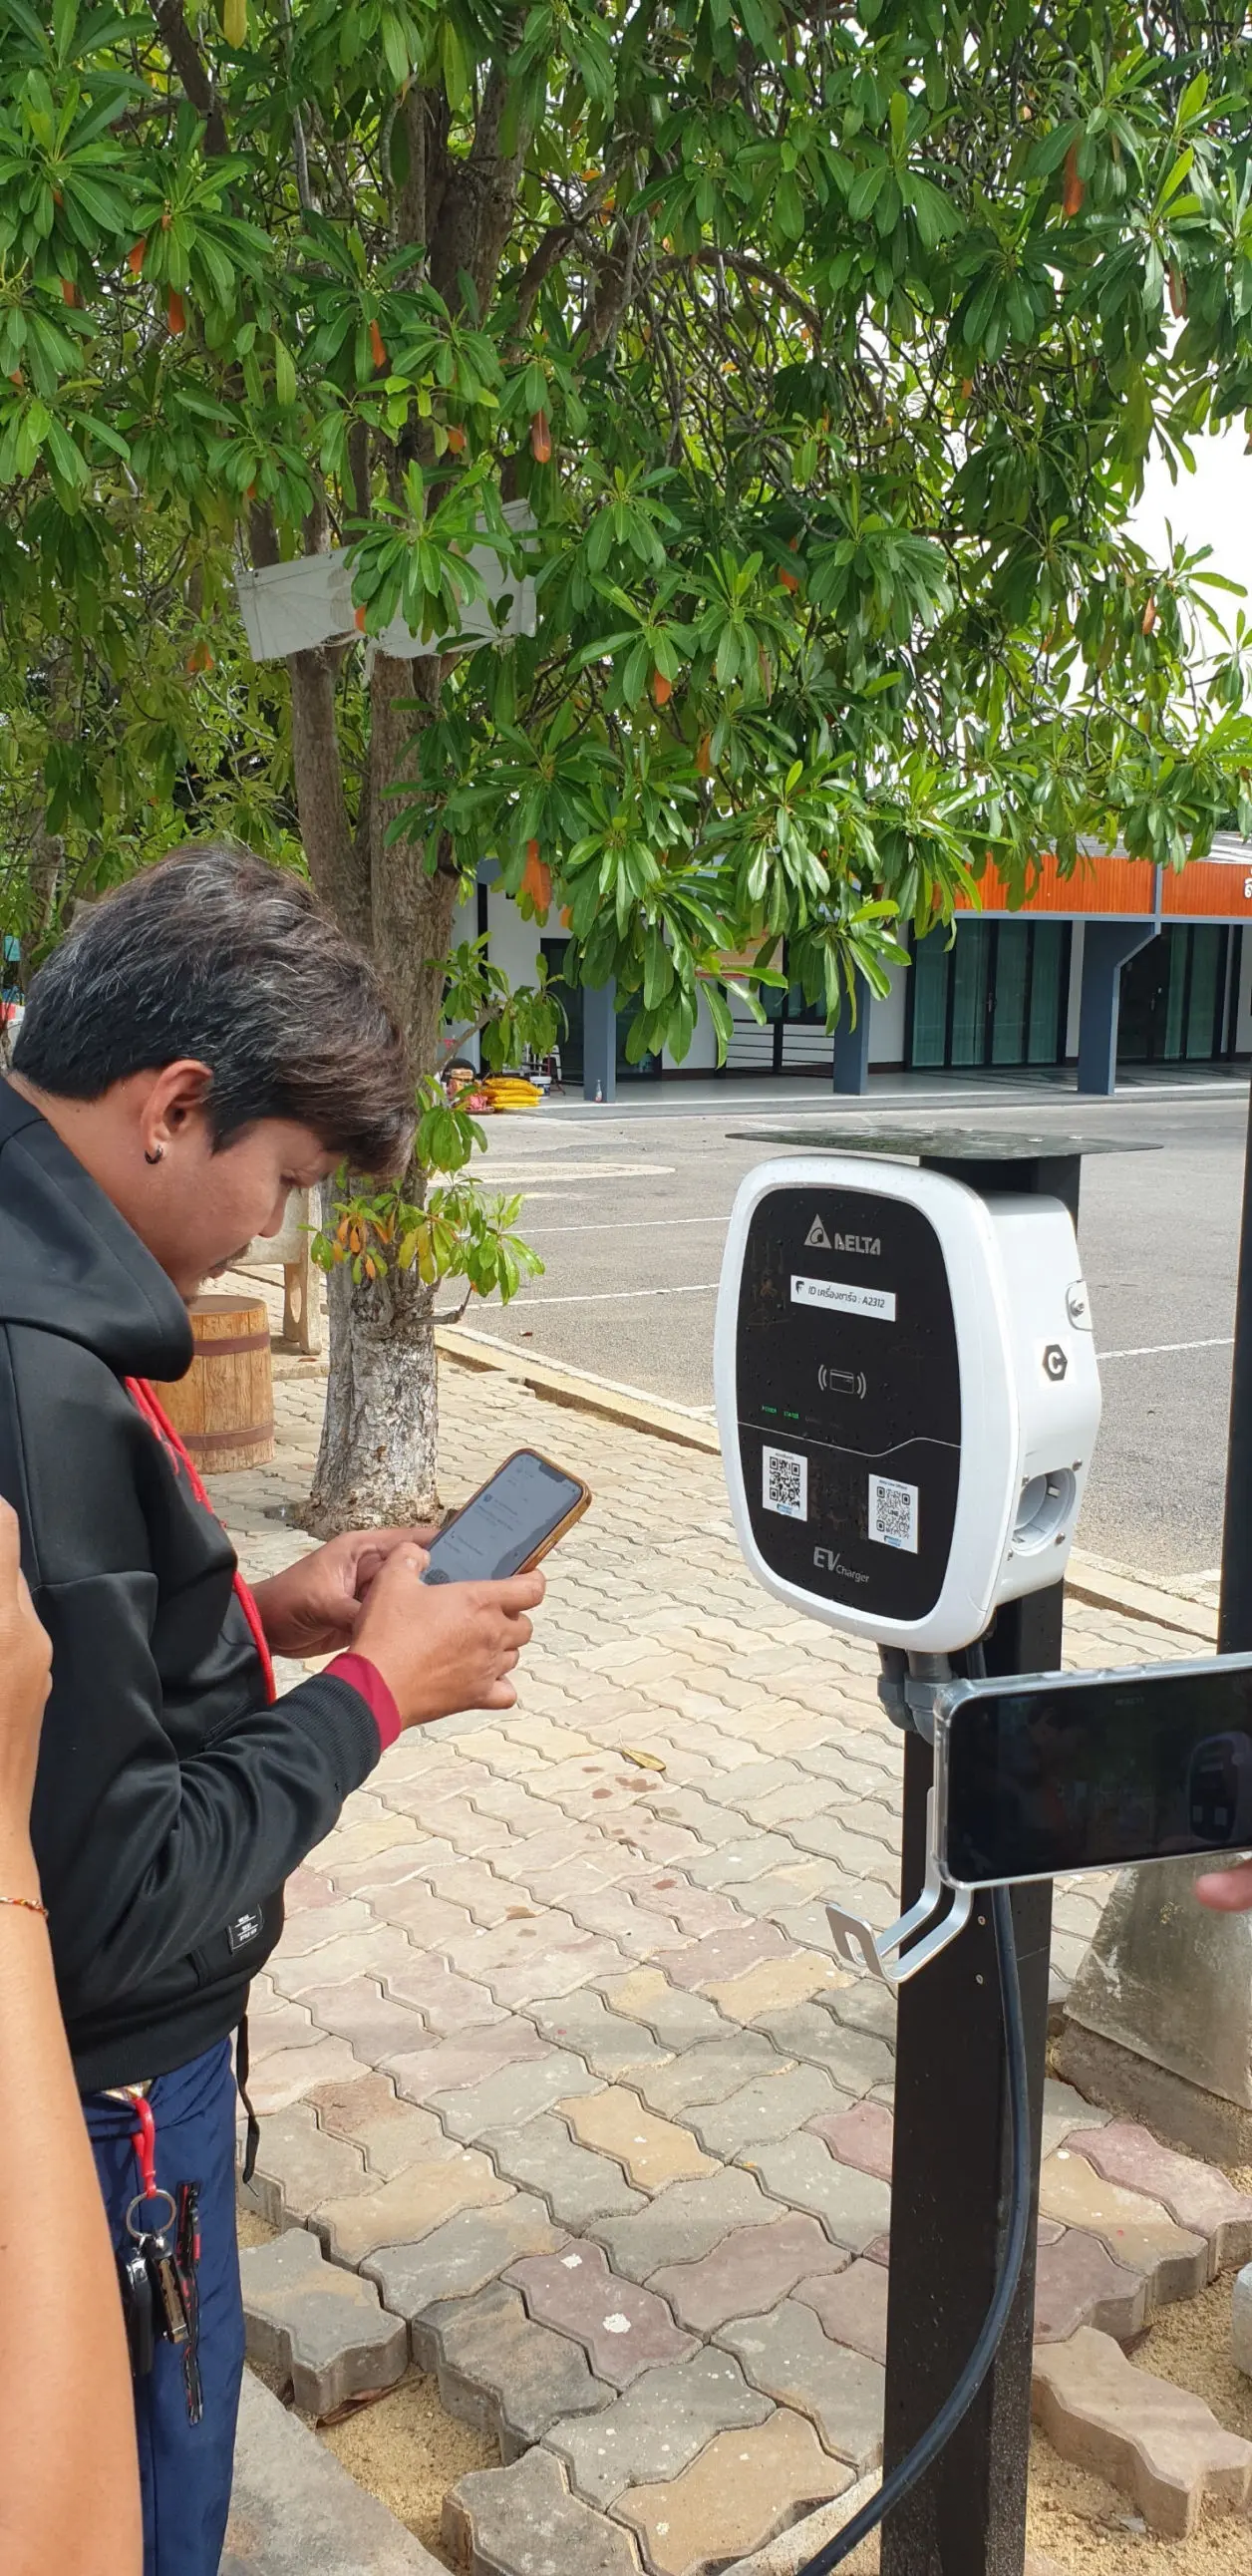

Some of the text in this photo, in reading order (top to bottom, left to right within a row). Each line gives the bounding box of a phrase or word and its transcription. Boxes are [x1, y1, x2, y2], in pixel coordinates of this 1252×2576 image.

[834, 1232, 881, 1256] DELTA
[808, 1285, 816, 1296] ID
[862, 1296, 885, 1308] A2312
[1048, 1351, 1063, 1375] C
[813, 1546, 870, 1583] EV Charger
